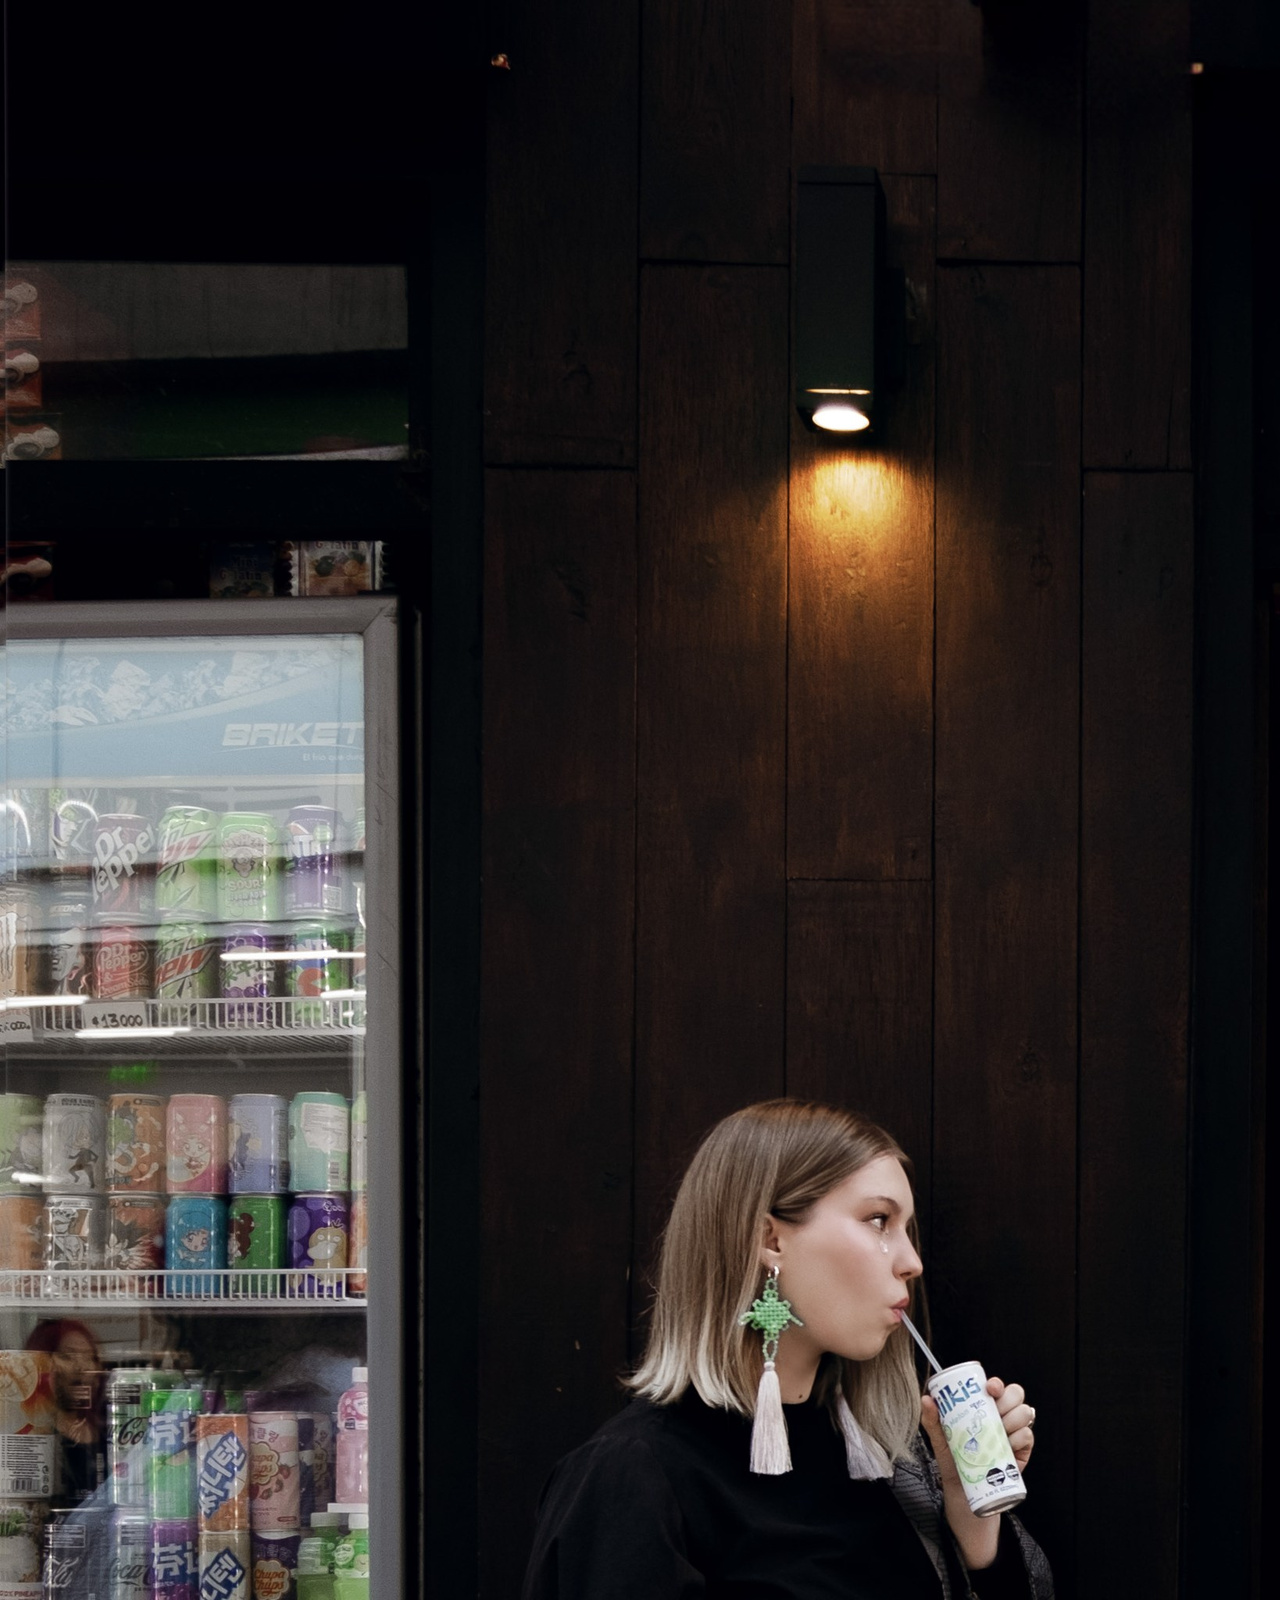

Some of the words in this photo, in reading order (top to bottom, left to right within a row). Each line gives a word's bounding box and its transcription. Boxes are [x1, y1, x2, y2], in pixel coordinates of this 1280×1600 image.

[222, 722, 364, 746] BRIKET
[936, 1377, 982, 1418] ilkis
[255, 1569, 285, 1581] Chupa
[254, 1580, 285, 1597] Chups
